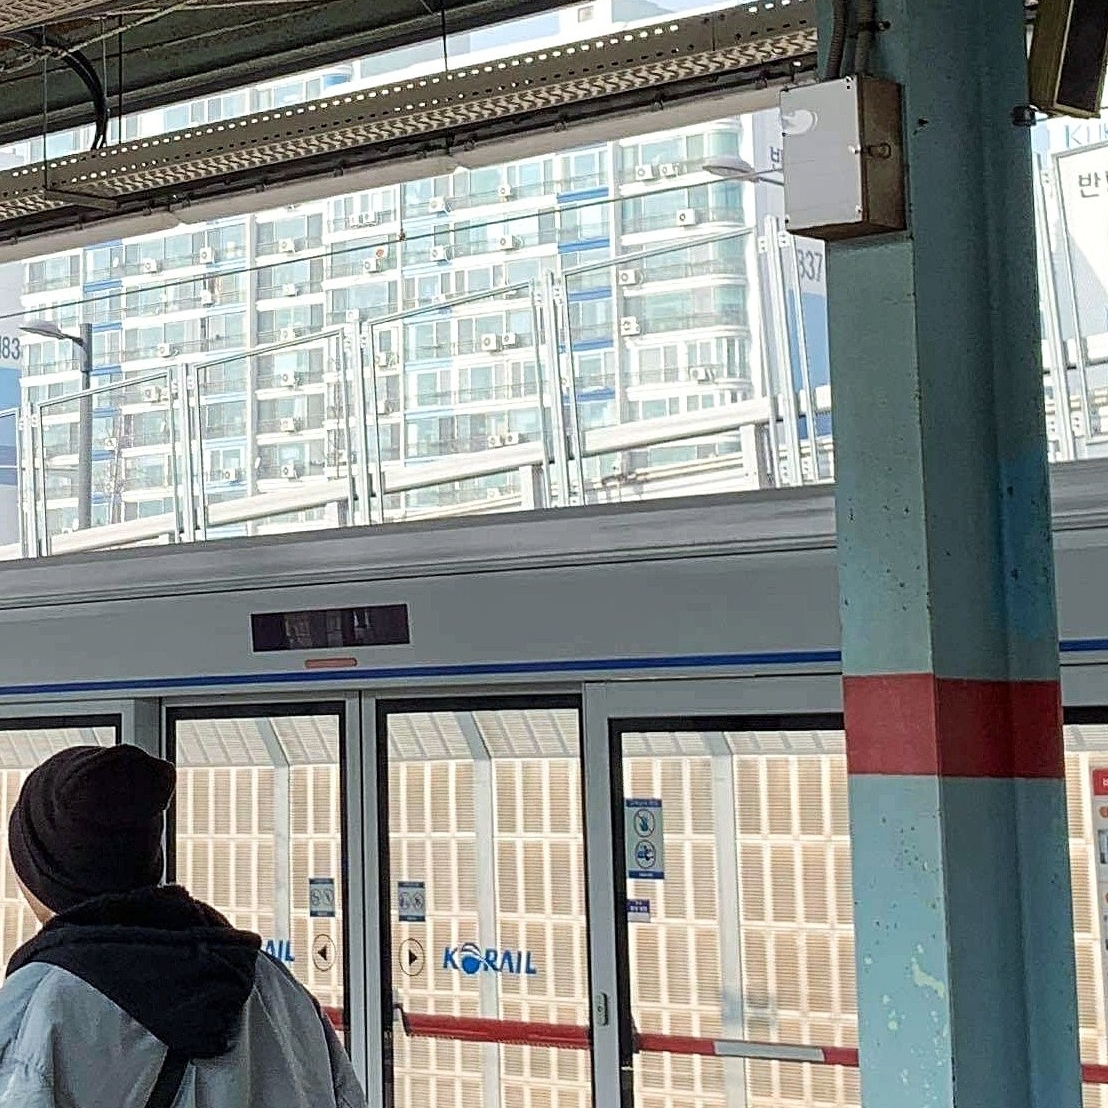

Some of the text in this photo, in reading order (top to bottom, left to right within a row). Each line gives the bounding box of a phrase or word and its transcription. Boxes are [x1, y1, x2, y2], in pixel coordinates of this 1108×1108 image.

[1078, 171, 1108, 198] 반
[265, 939, 296, 962] AIL
[442, 942, 537, 975] KORAIL
